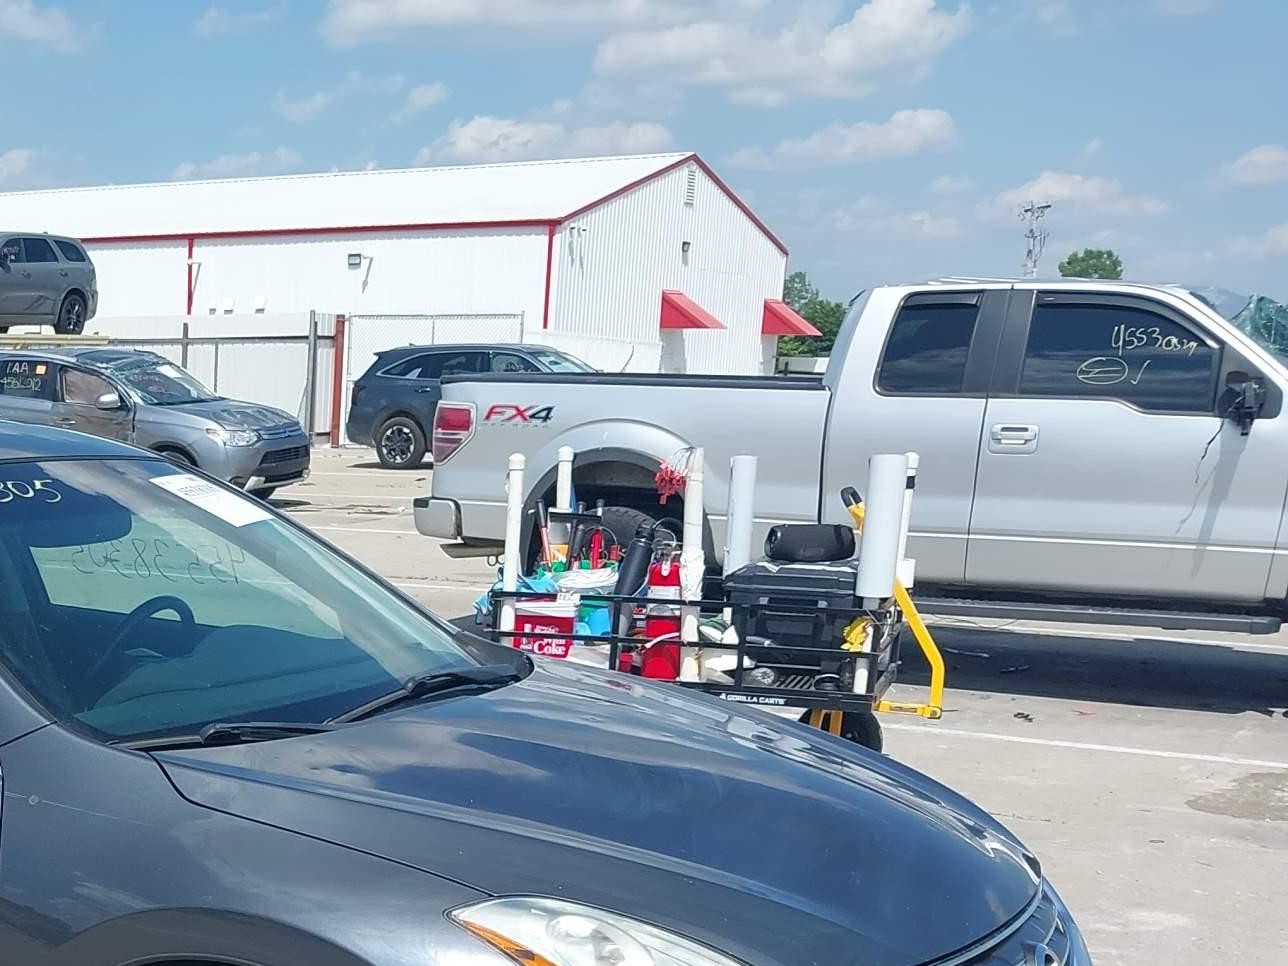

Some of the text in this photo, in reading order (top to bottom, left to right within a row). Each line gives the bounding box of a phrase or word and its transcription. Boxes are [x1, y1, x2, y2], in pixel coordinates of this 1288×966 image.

[482, 405, 555, 423] FX4
[533, 639, 566, 655] Coke
[727, 694, 786, 705] GORILLA CARTS
